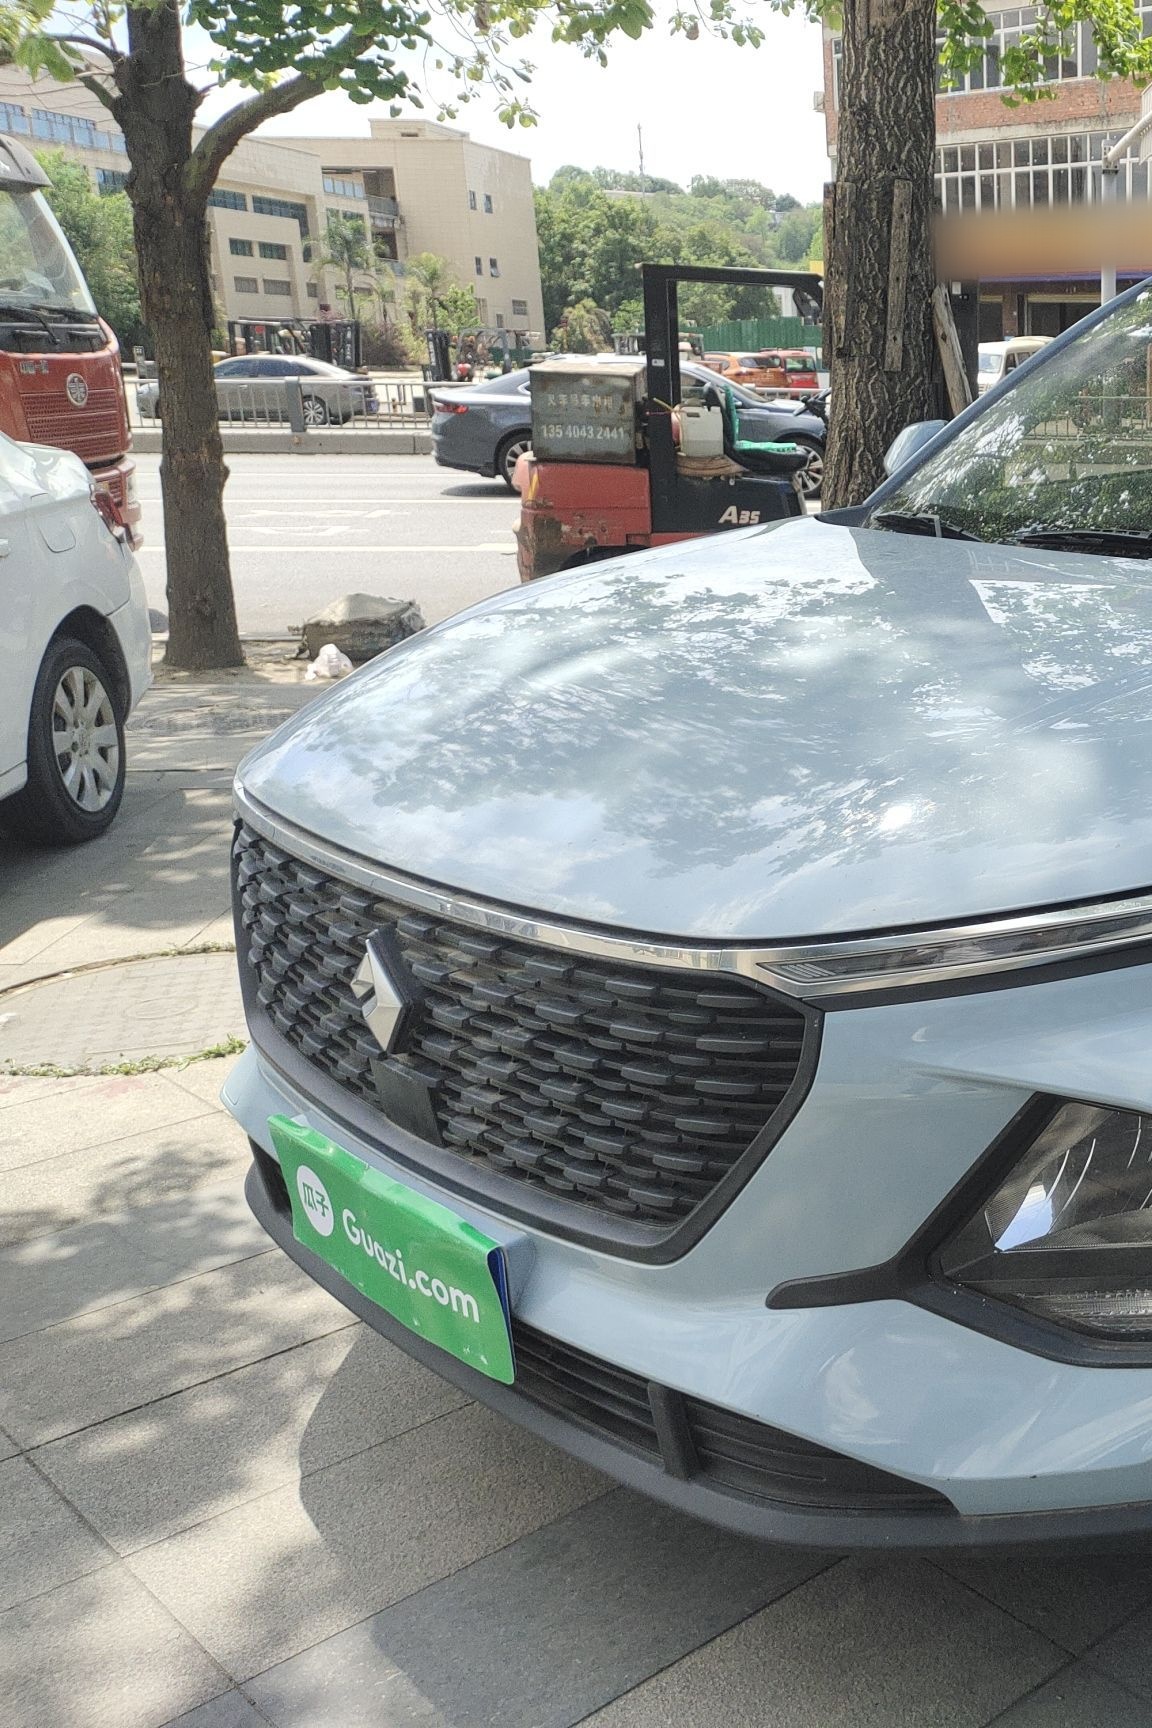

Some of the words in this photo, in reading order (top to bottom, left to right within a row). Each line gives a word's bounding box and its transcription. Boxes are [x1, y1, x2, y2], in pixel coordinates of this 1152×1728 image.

[542, 424, 563, 439] 135
[565, 424, 595, 440] 4043
[597, 426, 625, 440] 2441
[718, 505, 761, 524] A35
[302, 1182, 329, 1218] 瓜子
[342, 1208, 480, 1323] Guazi.com
